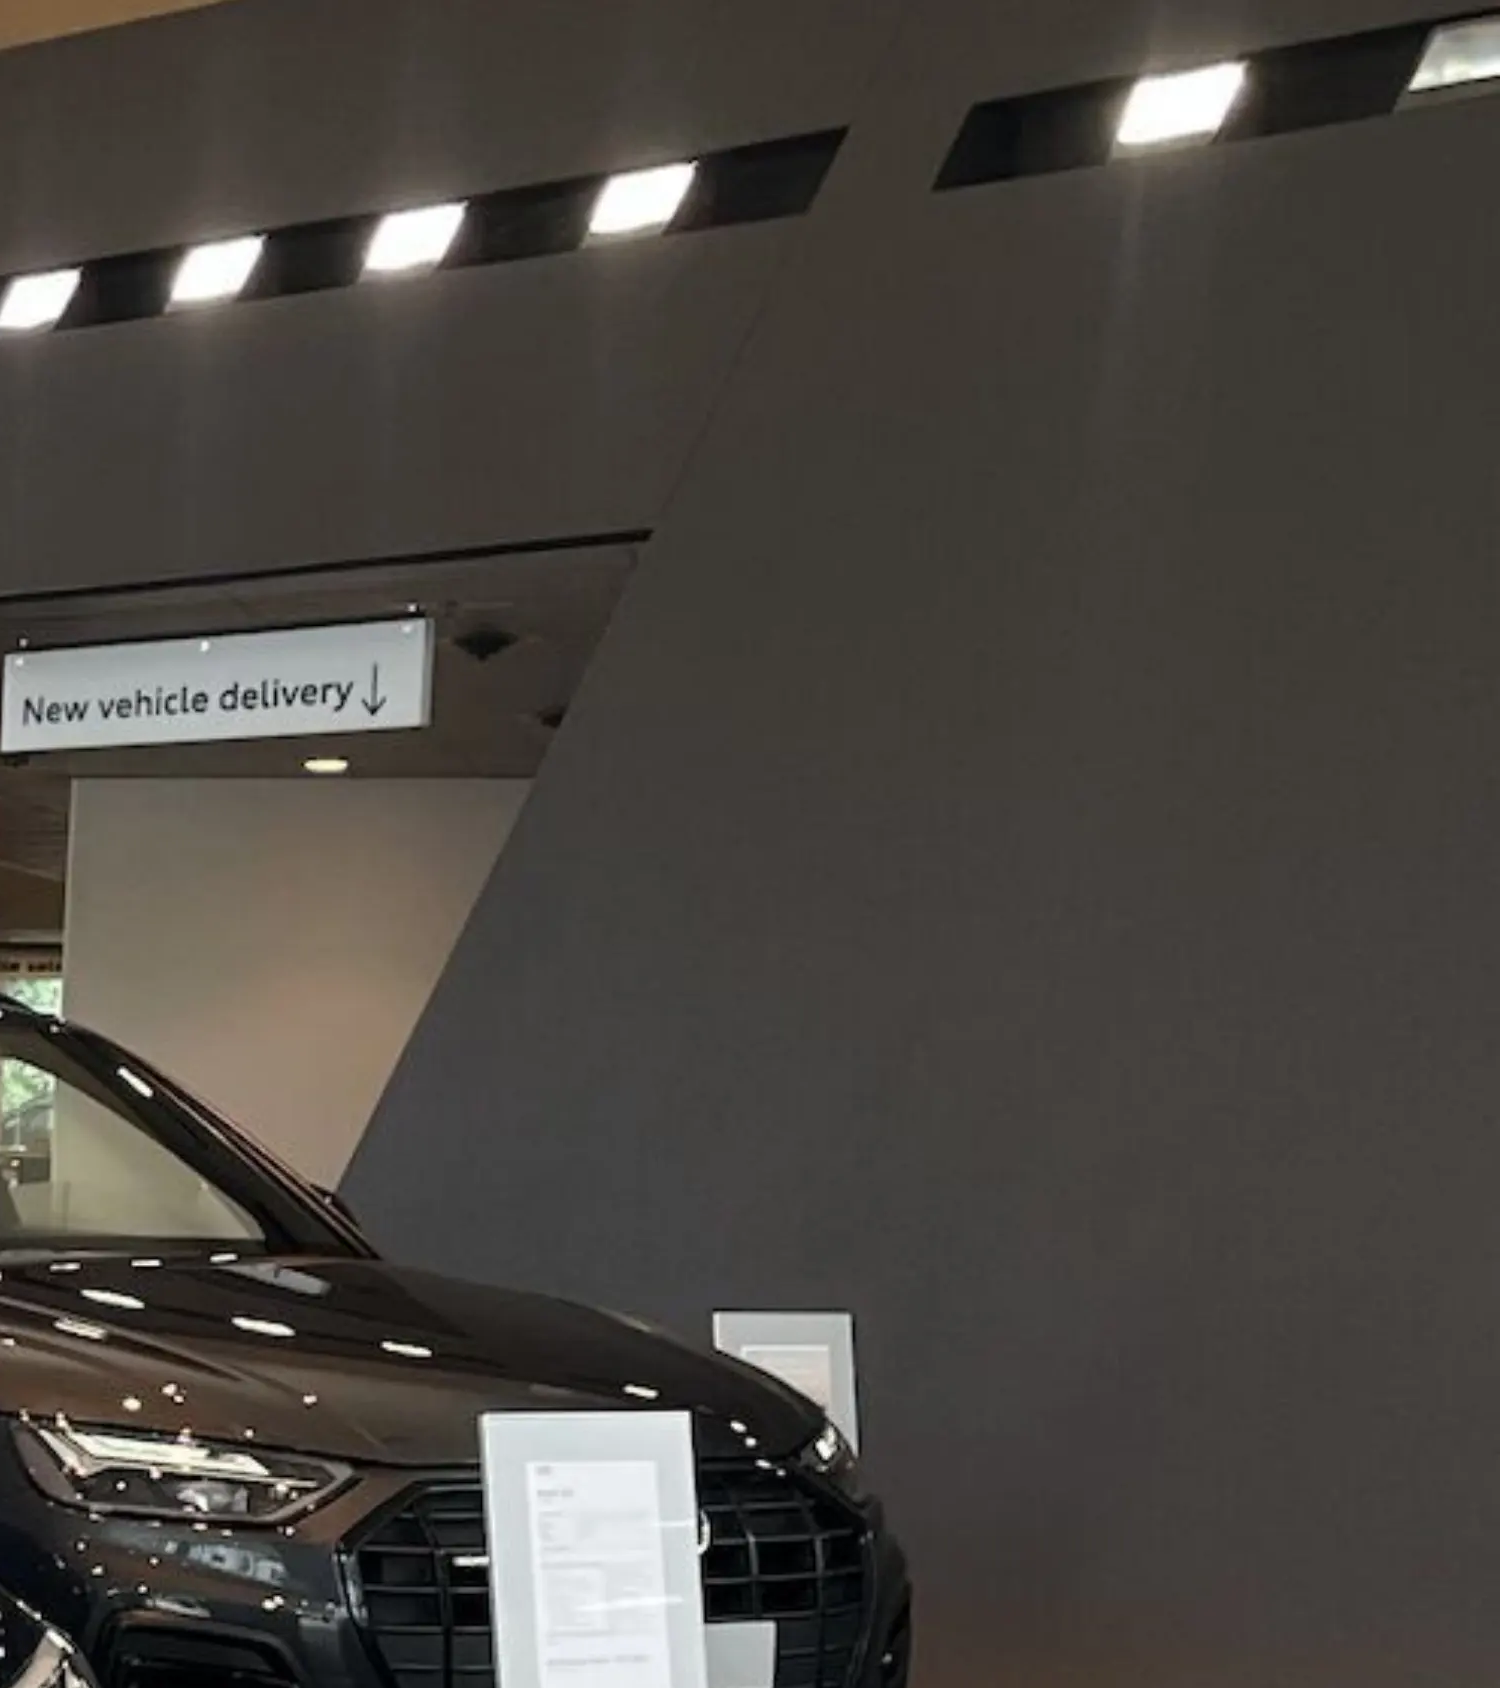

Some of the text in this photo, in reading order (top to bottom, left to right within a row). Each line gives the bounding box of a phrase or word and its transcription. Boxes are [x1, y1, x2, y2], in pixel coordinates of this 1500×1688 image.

[22, 675, 356, 725] New vehicle delivery
